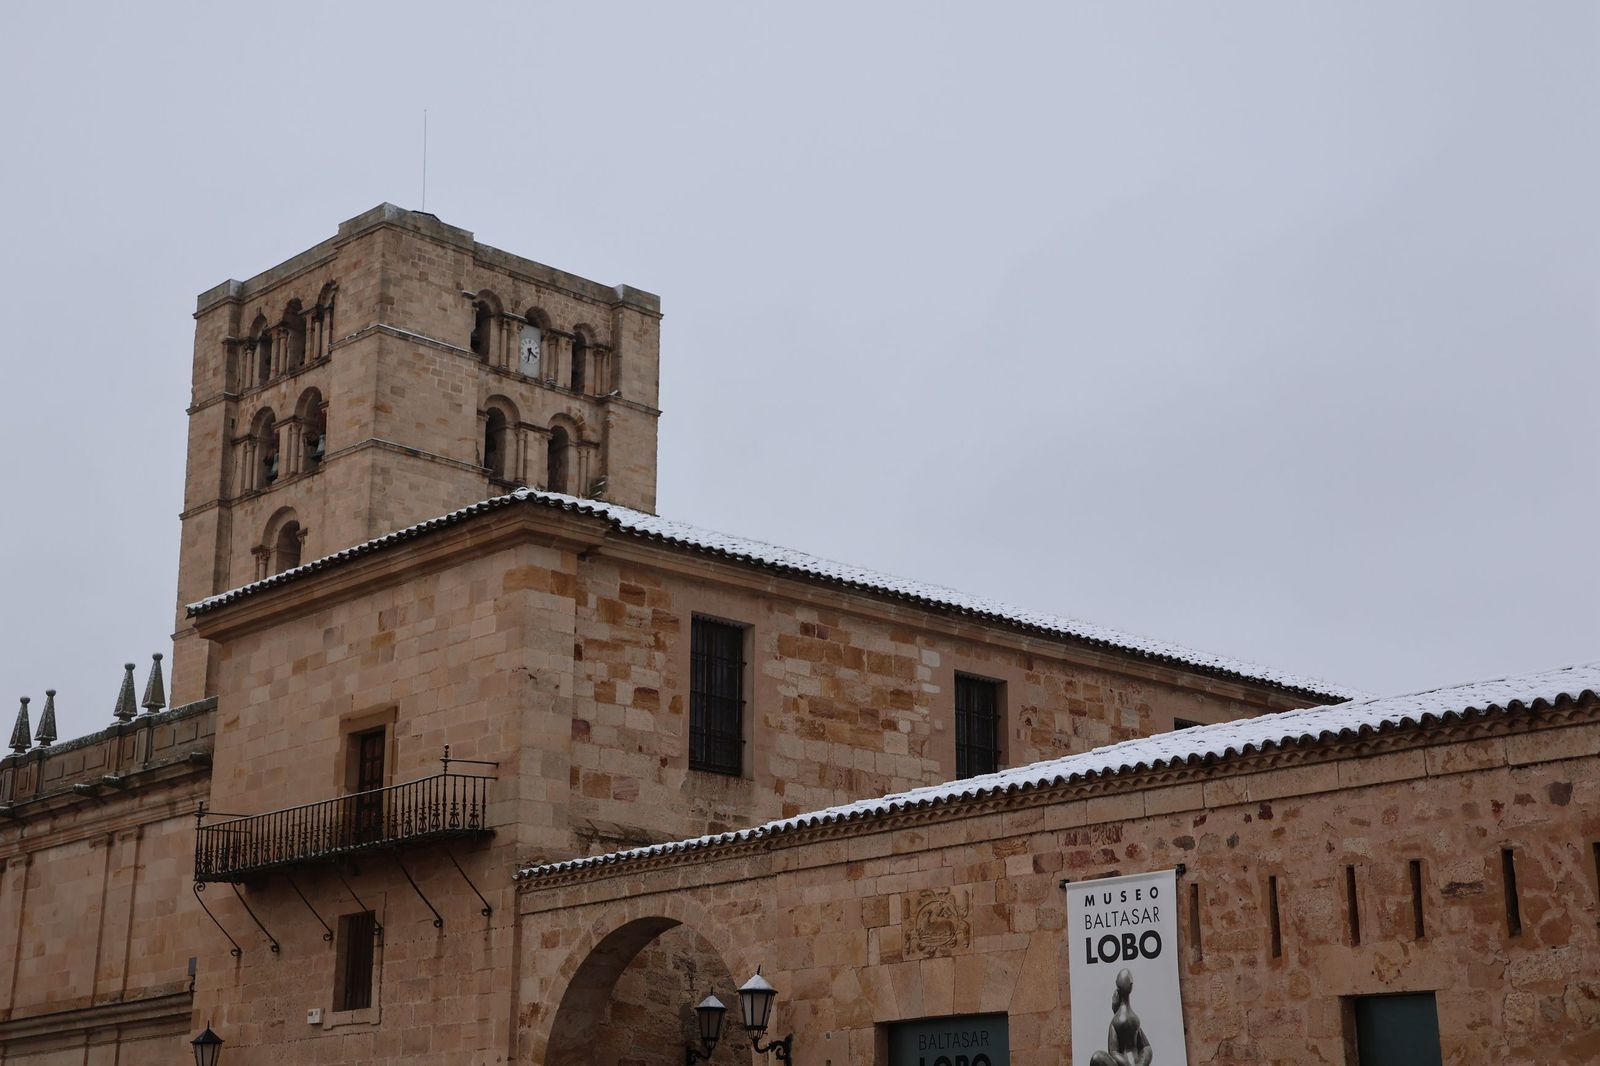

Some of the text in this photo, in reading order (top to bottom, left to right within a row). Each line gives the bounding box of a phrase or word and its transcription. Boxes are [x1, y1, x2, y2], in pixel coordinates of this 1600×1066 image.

[1084, 886, 1159, 907] MUSEO
[1085, 906, 1161, 930] BALTASAR
[1086, 929, 1162, 965] LOBO
[918, 1030, 990, 1051] BALTASAR
